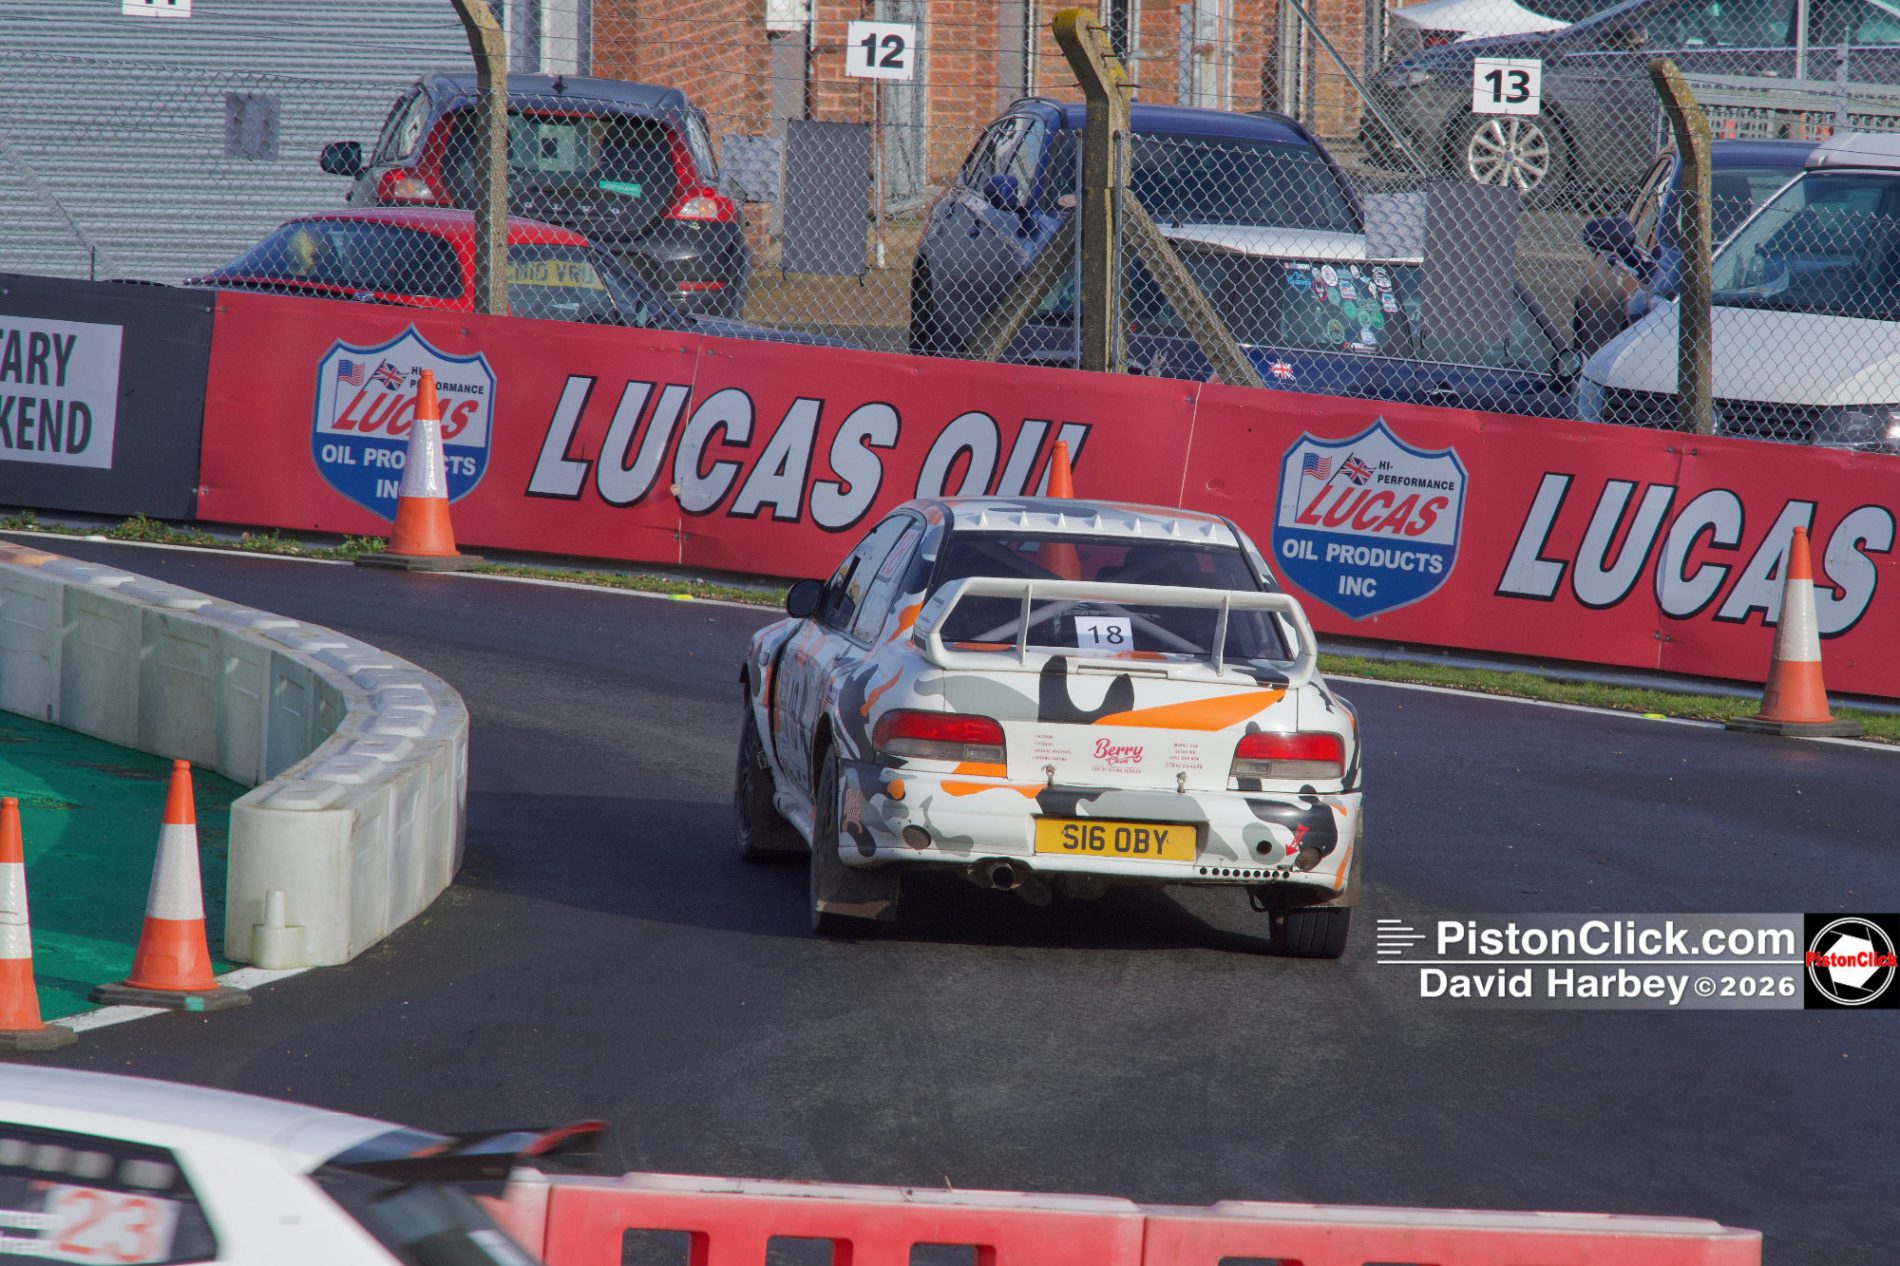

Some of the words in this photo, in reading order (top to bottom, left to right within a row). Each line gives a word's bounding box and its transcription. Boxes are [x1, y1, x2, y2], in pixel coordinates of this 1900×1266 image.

[861, 32, 905, 69] 12
[1484, 69, 1530, 104] 13
[0, 329, 77, 387] ARY
[410, 379, 484, 395] PORMANCE
[321, 444, 357, 465] OIL
[363, 447, 477, 477] PROTS
[525, 374, 902, 533] LUCAS
[1378, 460, 1394, 471] HI-
[375, 478, 400, 499] IN
[1377, 474, 1455, 491] PERFORMANCE
[1295, 483, 1450, 537] LUCAS
[1282, 538, 1319, 560] OIL
[1326, 543, 1443, 575] PRODUCTS
[1493, 471, 1897, 639] LUCAS
[1338, 575, 1378, 598] INC
[1087, 624, 1125, 645] 18
[1093, 737, 1144, 764] Berry
[1062, 823, 1106, 851] S16
[1114, 827, 1169, 855] OBY
[55, 1189, 162, 1262] 23
